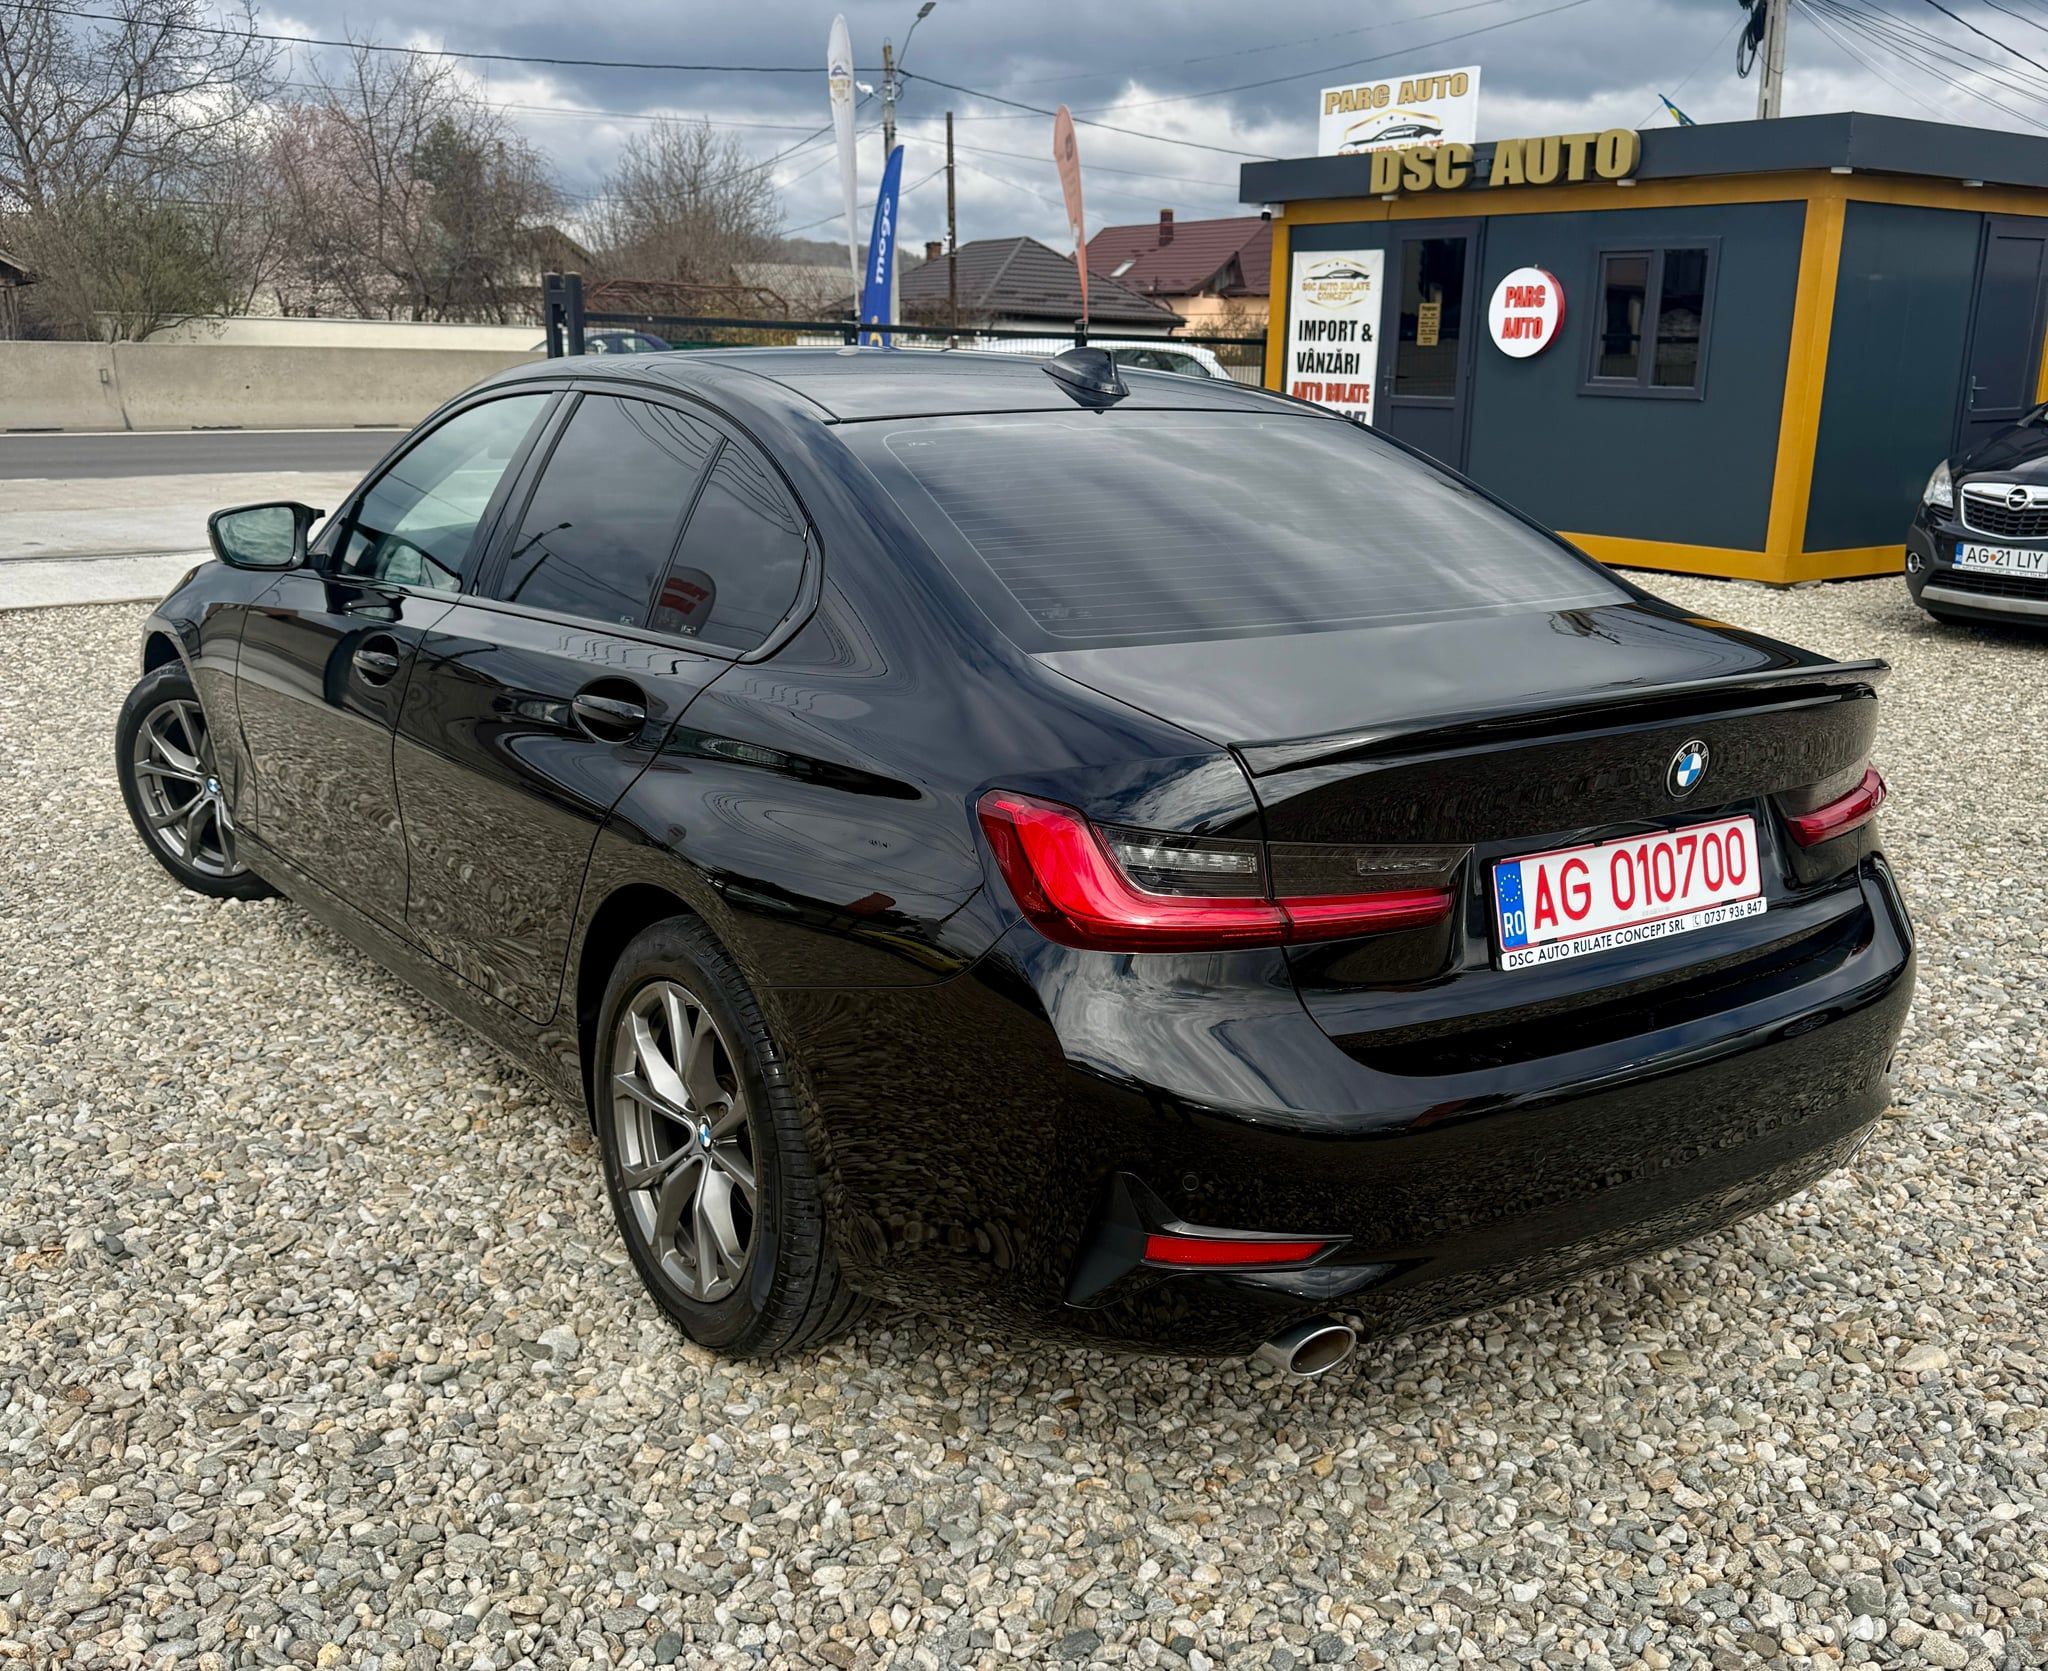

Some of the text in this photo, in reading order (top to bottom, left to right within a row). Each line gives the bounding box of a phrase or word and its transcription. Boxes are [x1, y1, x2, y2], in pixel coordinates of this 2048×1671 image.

[1325, 72, 1469, 115] PARC AUTO
[1370, 128, 1640, 194] DSC AUTO
[875, 197, 891, 285] mogo
[1504, 285, 1546, 308] PARC
[1298, 319, 1373, 342] IMPORT &
[1501, 317, 1543, 339] AUTO
[1297, 347, 1360, 375] VÂNZĂRI
[1292, 381, 1370, 404] AUTO RULATE
[1965, 547, 1989, 564] AG
[1995, 550, 2011, 567] 21
[2017, 551, 2044, 569] LIY
[1678, 743, 1709, 763] BMW
[1534, 826, 1747, 930] AG 010700
[1503, 910, 1525, 938] RO
[1509, 900, 1762, 967] DSC AUTO RULATE CONCEPT SRL 0737 936 847
